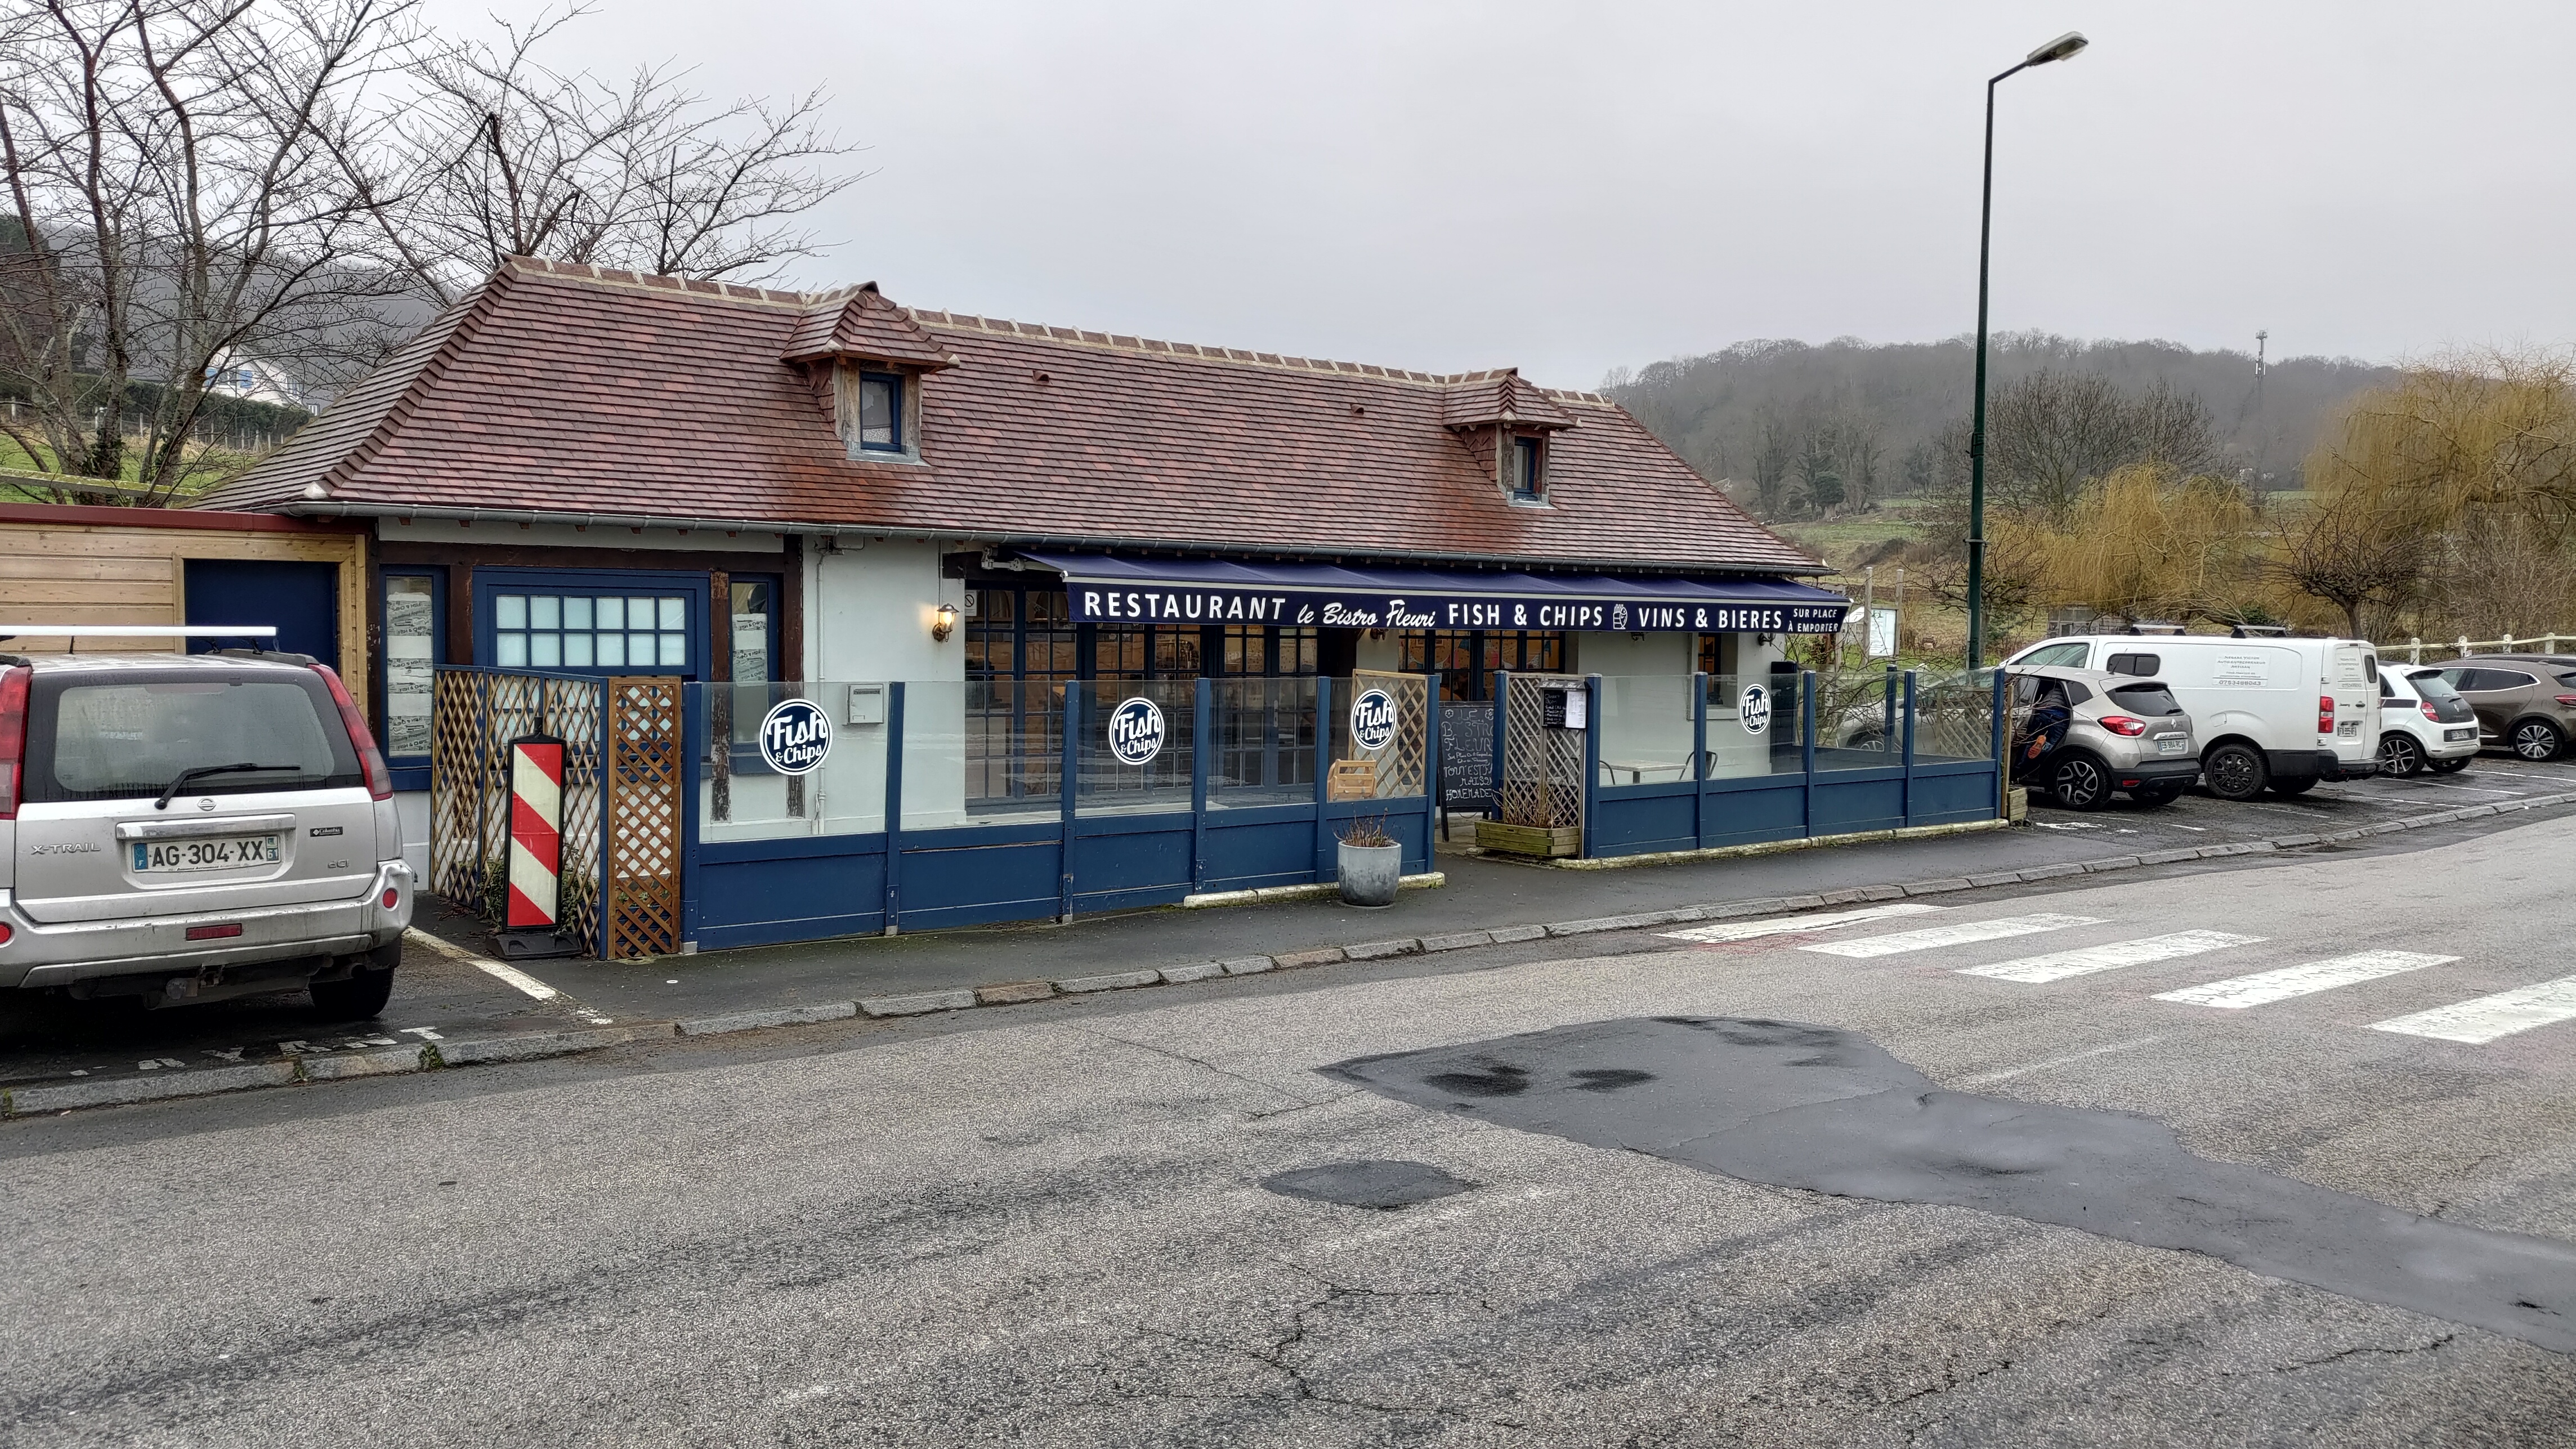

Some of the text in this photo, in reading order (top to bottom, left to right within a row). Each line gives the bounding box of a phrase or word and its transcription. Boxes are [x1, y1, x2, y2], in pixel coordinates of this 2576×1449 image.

[1085, 592, 1782, 629] RESTAURANT le Bistro Fleuri FISH & CHIPS VINS & BIERES
[1794, 608, 1837, 618] SUR PLACE
[1788, 620, 1838, 632] À EMPORTER
[1743, 693, 1768, 717] Fish
[1356, 701, 1393, 728] Fish
[1750, 714, 1766, 727] Chips
[767, 712, 826, 750] Fish
[1115, 709, 1160, 743] Fish
[1365, 726, 1389, 742] Chips
[776, 744, 822, 764] & Chips
[1121, 738, 1156, 755] & Chips
[31, 843, 101, 855] X-TRAIL
[153, 840, 263, 867] AG-304-XX
[267, 849, 278, 858] 61
